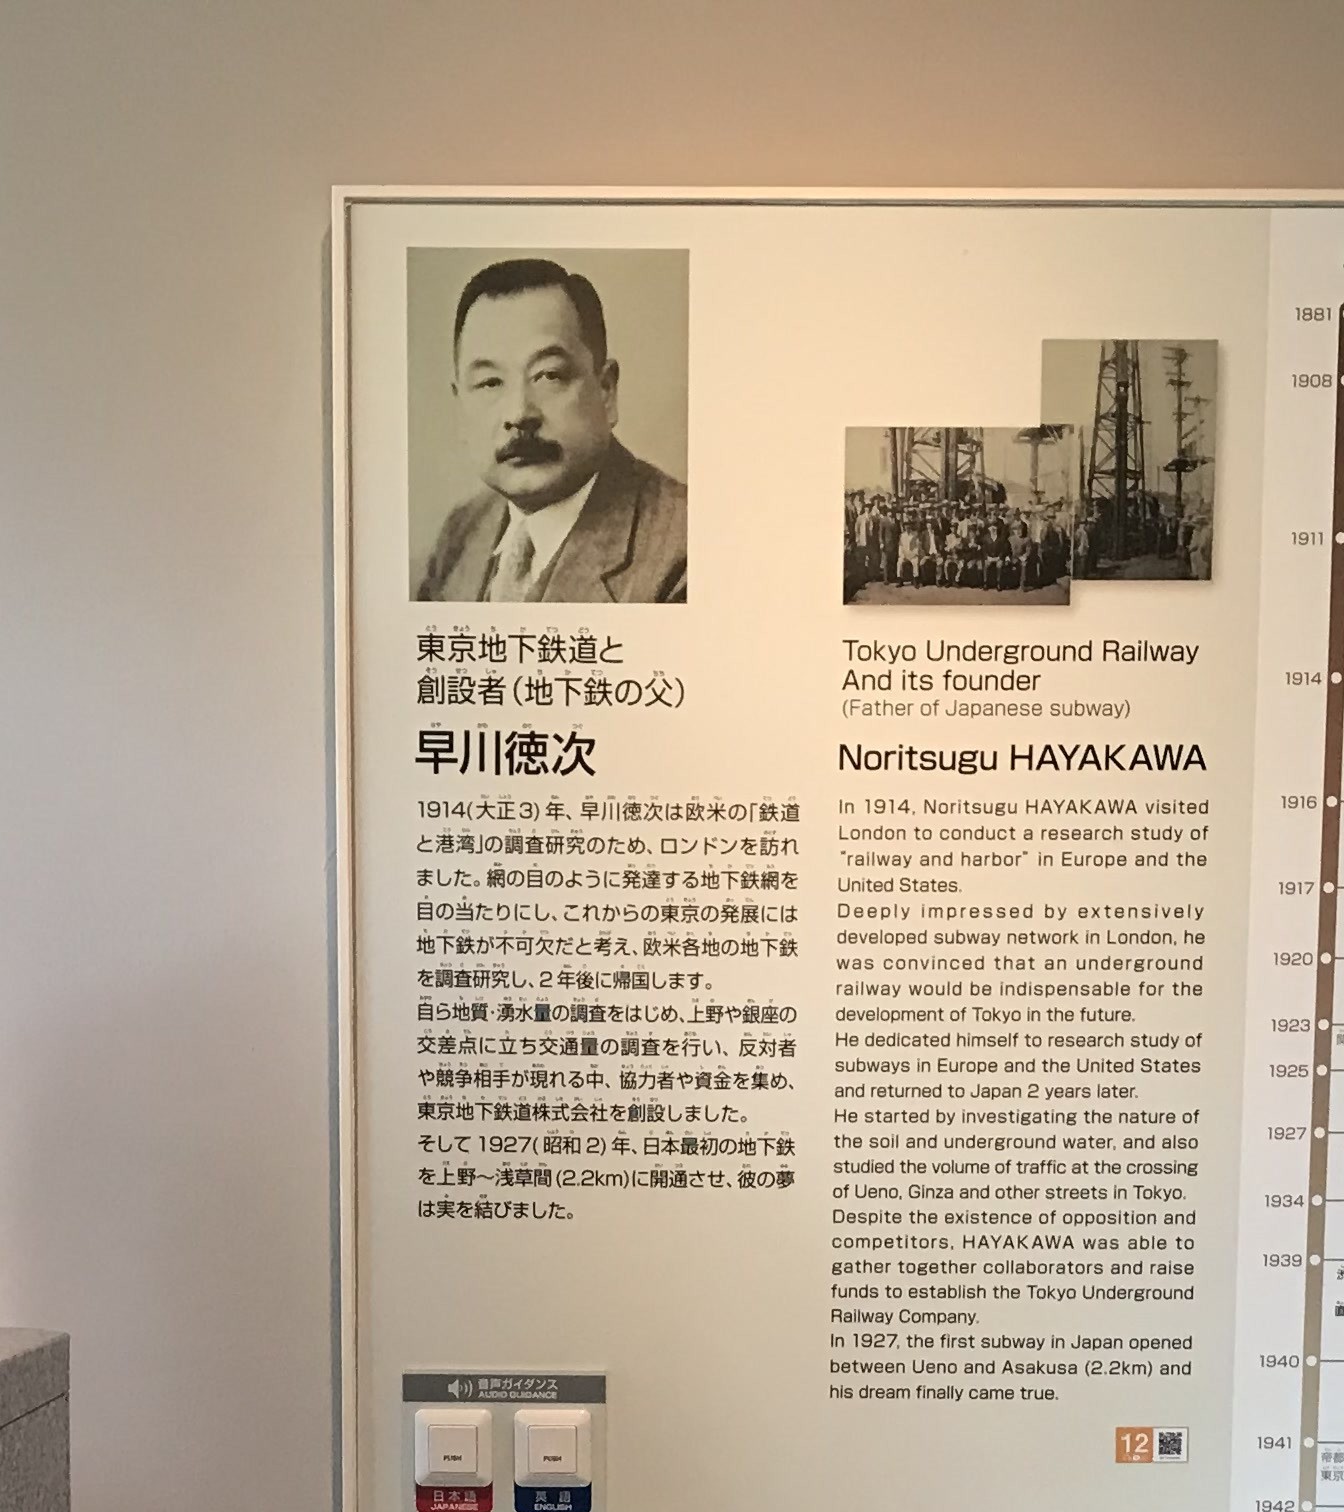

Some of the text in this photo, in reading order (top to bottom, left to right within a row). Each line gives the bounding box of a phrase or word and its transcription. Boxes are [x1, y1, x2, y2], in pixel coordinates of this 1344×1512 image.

[1296, 307, 1331, 321] 1881
[1292, 374, 1332, 388] 1908
[1292, 532, 1323, 545] 1911
[416, 632, 623, 664] 東京地下鉄道と
[841, 640, 1200, 665] Tokyo Underground Railway
[841, 669, 1042, 691] And its founder
[1286, 672, 1322, 685] 1914
[842, 699, 1131, 719] (Father of Japanese subway)
[415, 728, 596, 777] 早川徳次
[838, 744, 1208, 775] Noritsugu HAYAKAWA
[839, 799, 1209, 816] In 1914, Noritsugu HAYAKAWA visited
[1281, 796, 1317, 809] 1916
[838, 826, 1209, 843] London to conduct a research study of
[1279, 882, 1314, 895] 1917
[837, 903, 1205, 921] Deeply impressed by extensively
[836, 930, 1206, 946] developed subway network in London, he
[1274, 952, 1313, 966] 1920
[836, 981, 1203, 999] railway would be indispensable for the
[1272, 1019, 1310, 1032] 1923
[1270, 1064, 1309, 1078] 1925
[418, 1101, 747, 1123] 東京地下鉄道株式会社を創設しました。
[1268, 1127, 1306, 1140] 1927
[833, 1134, 1199, 1152] the soil and underground water, and also
[1265, 1194, 1304, 1208] 1934
[418, 1200, 573, 1219] は実を結びました。
[831, 1259, 1195, 1276] gather together collaborators and raise
[1263, 1254, 1302, 1267] 1939
[830, 1284, 1195, 1302] funds to establish the Tokyo Underground
[830, 1309, 980, 1326] Railway Company.
[1260, 1355, 1299, 1368] 1940
[478, 1378, 558, 1390] 音声ガイダンス
[478, 1391, 558, 1399] AUDIO GUIDANCE
[829, 1385, 1059, 1401] his dream finally came true.
[1121, 1432, 1149, 1454] 12
[1258, 1437, 1291, 1449] 1941
[534, 1503, 573, 1511] ENGLISH
[1256, 1500, 1295, 1512] 1942
